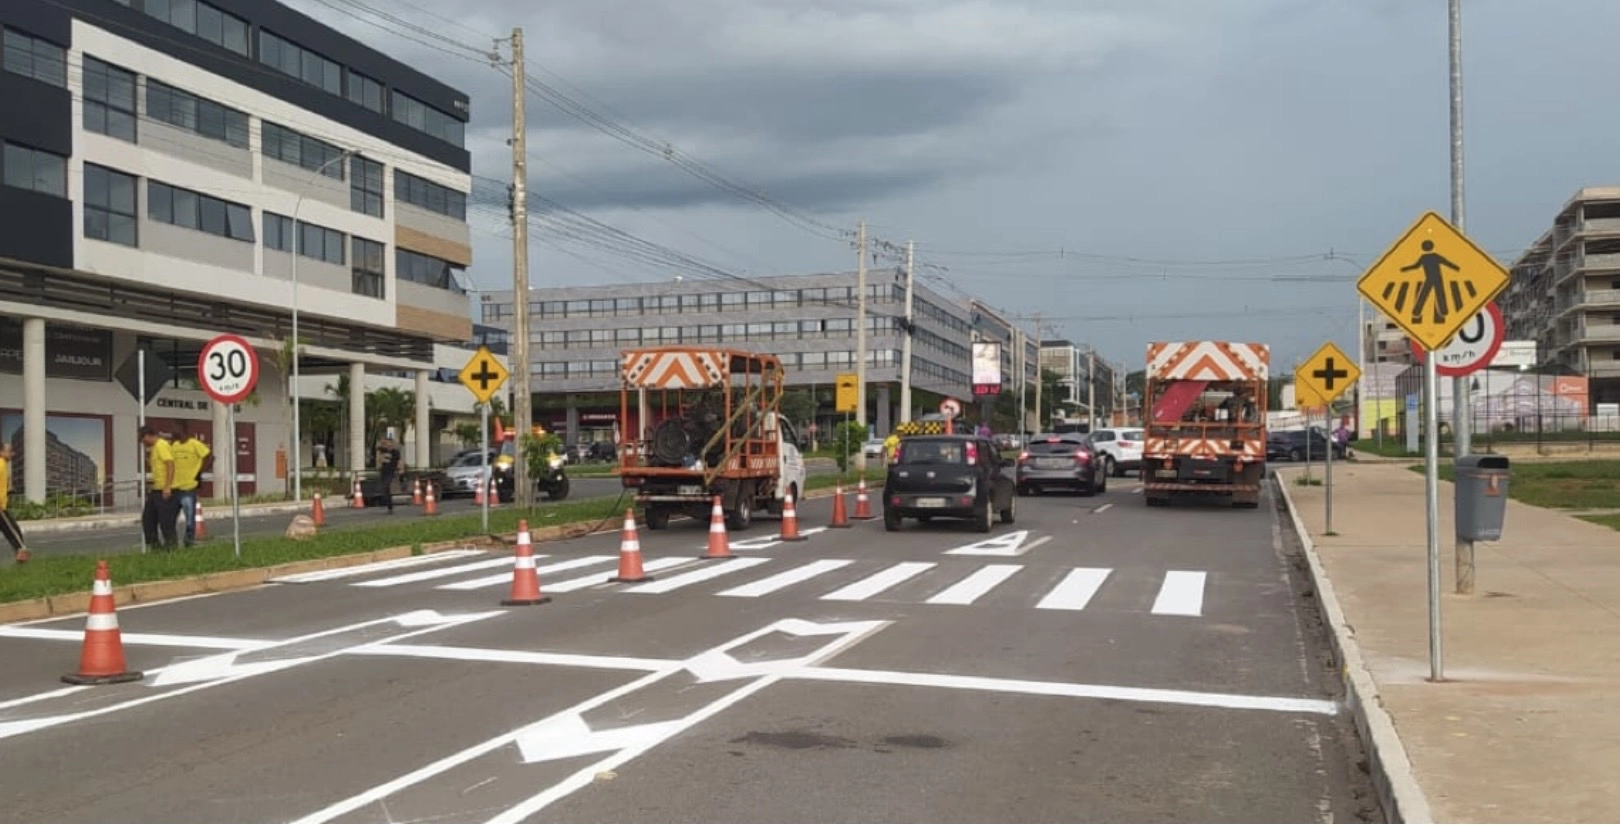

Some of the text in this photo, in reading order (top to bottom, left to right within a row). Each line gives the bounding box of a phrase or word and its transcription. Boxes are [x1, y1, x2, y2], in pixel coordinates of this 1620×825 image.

[209, 348, 246, 381] 30
[156, 398, 194, 410] CENTRAL
[197, 400, 209, 411] DE
